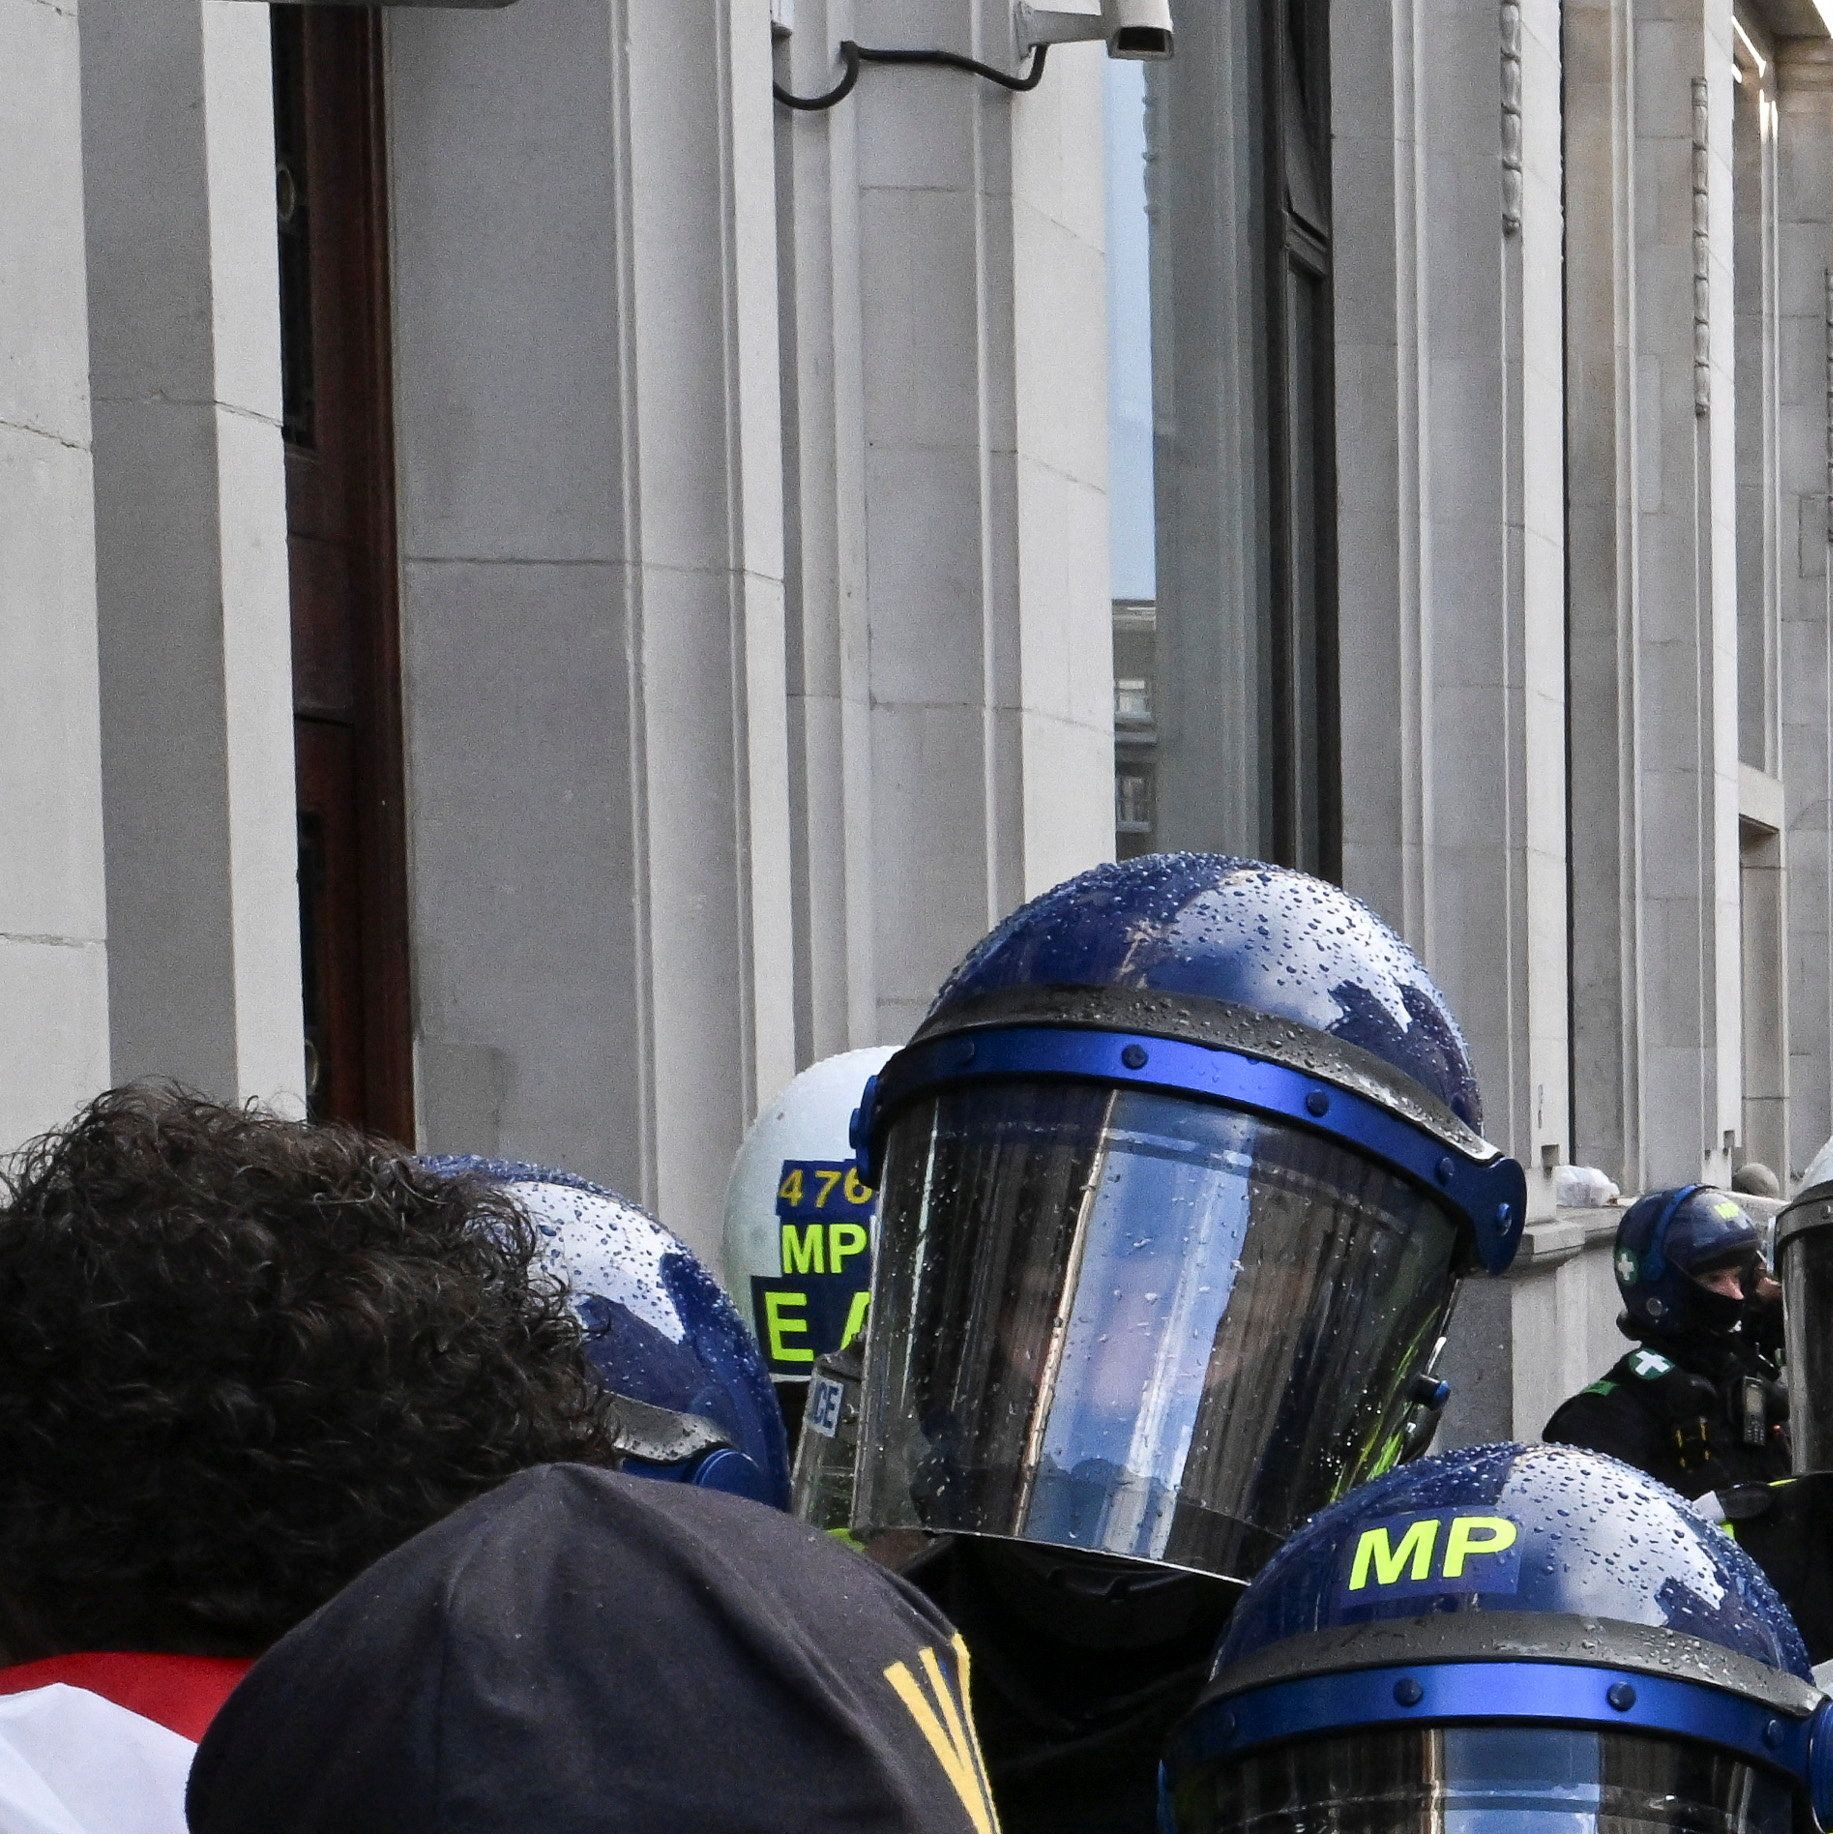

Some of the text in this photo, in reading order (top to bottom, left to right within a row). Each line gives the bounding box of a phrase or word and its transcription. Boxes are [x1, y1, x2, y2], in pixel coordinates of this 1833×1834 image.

[779, 1167, 874, 1208] 476
[782, 1223, 867, 1274] MP
[1349, 1515, 1518, 1591] MP
